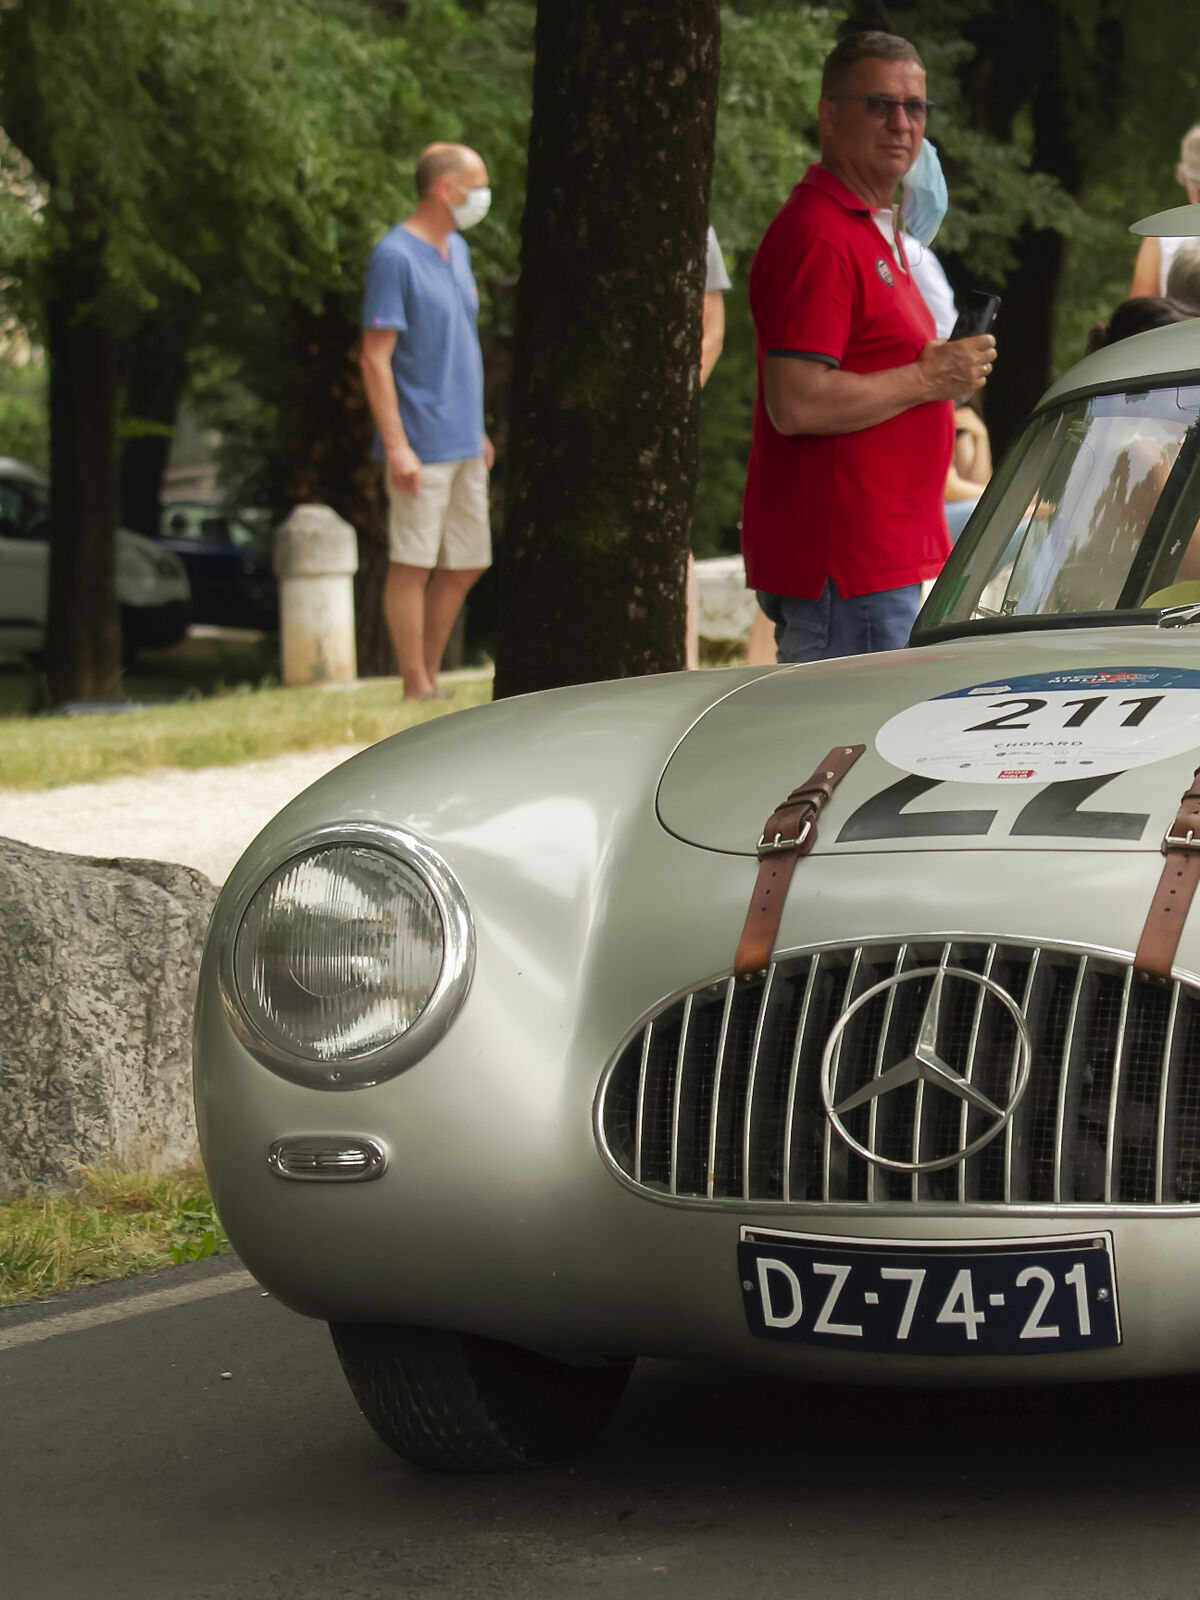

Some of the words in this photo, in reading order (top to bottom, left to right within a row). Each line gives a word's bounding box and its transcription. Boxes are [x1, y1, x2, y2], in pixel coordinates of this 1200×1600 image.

[963, 695, 1166, 732] 211
[994, 741, 1083, 749] CHOPARD
[756, 1257, 1092, 1341] DZ-74-21
